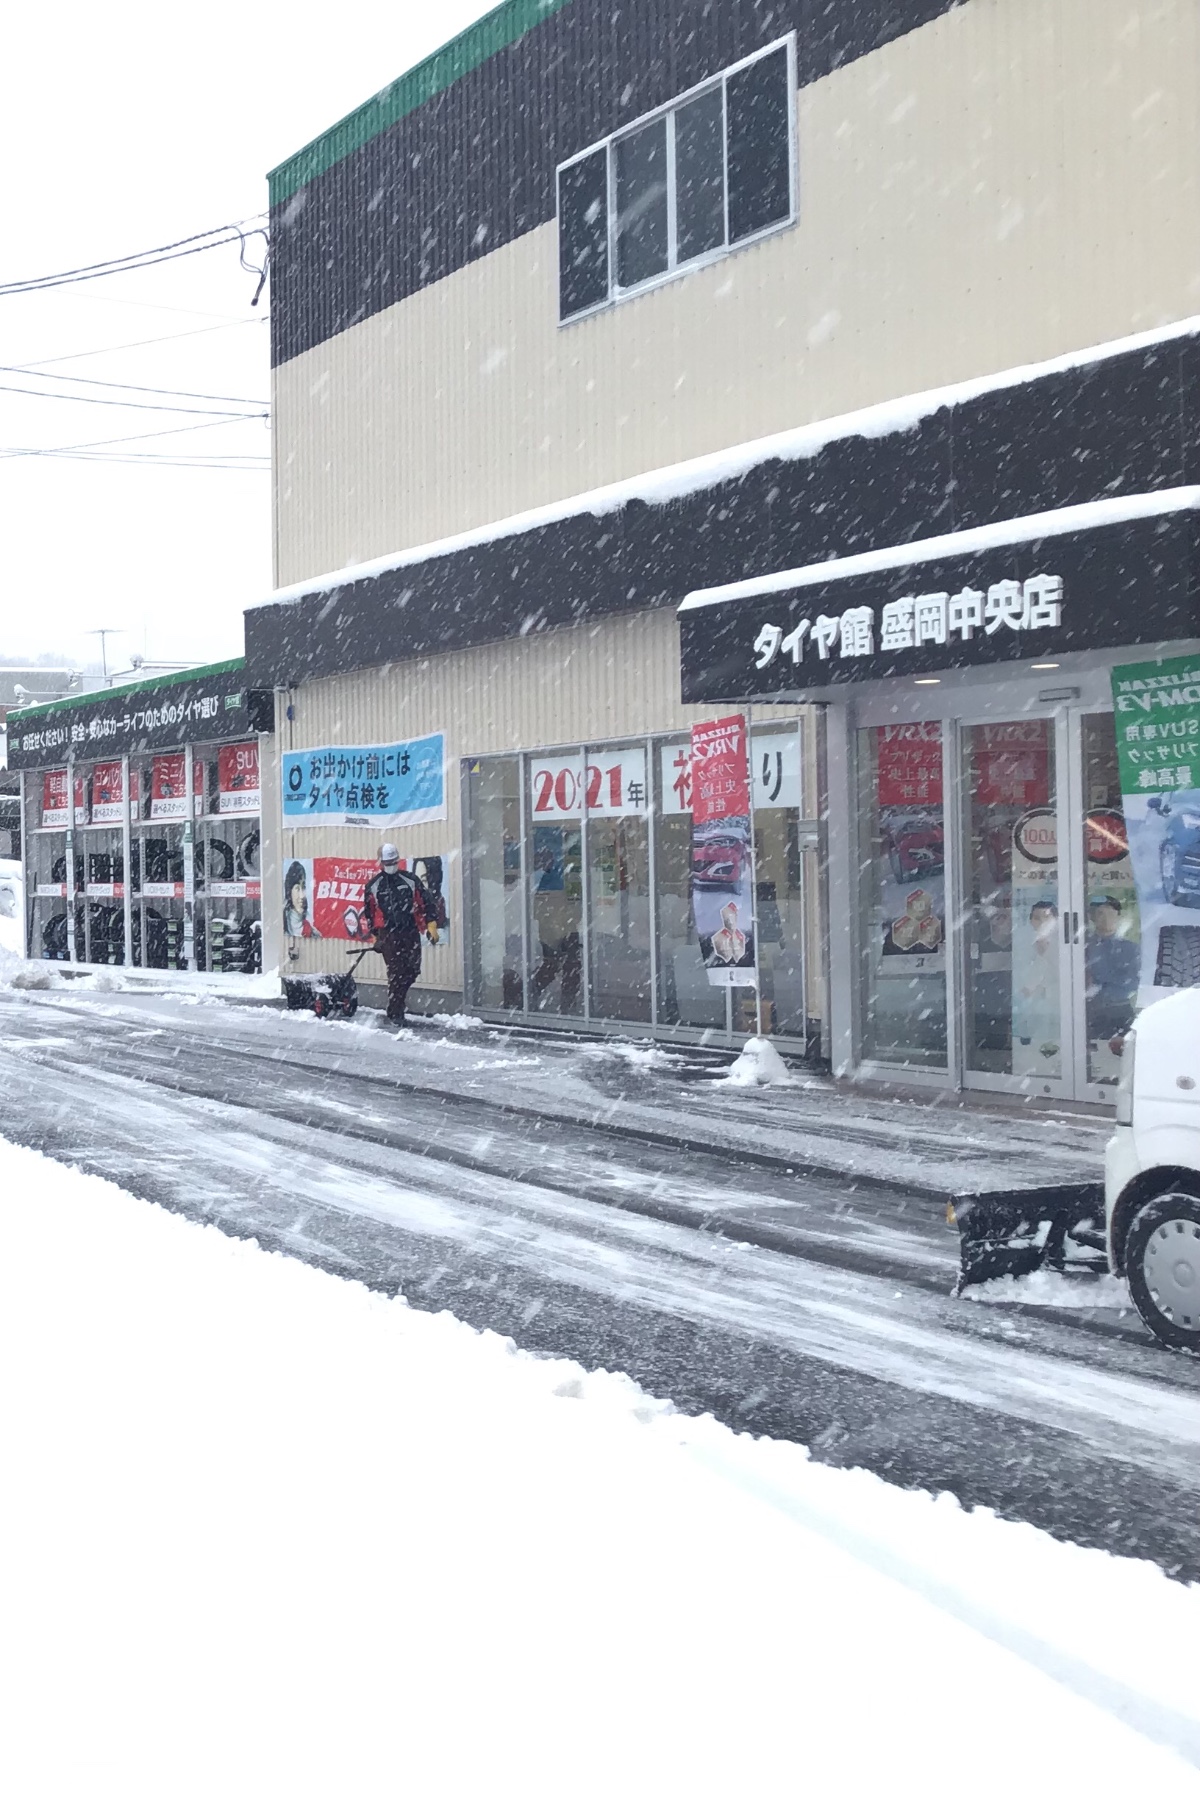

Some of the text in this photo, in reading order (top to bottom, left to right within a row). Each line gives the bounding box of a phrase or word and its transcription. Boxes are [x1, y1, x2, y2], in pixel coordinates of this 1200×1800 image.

[753, 574, 1063, 669] タイヤ館 盛岡中央店
[310, 750, 411, 779] お出かけ前には
[309, 782, 390, 809] タイヤ点検を
[317, 880, 365, 902] BLIZ
